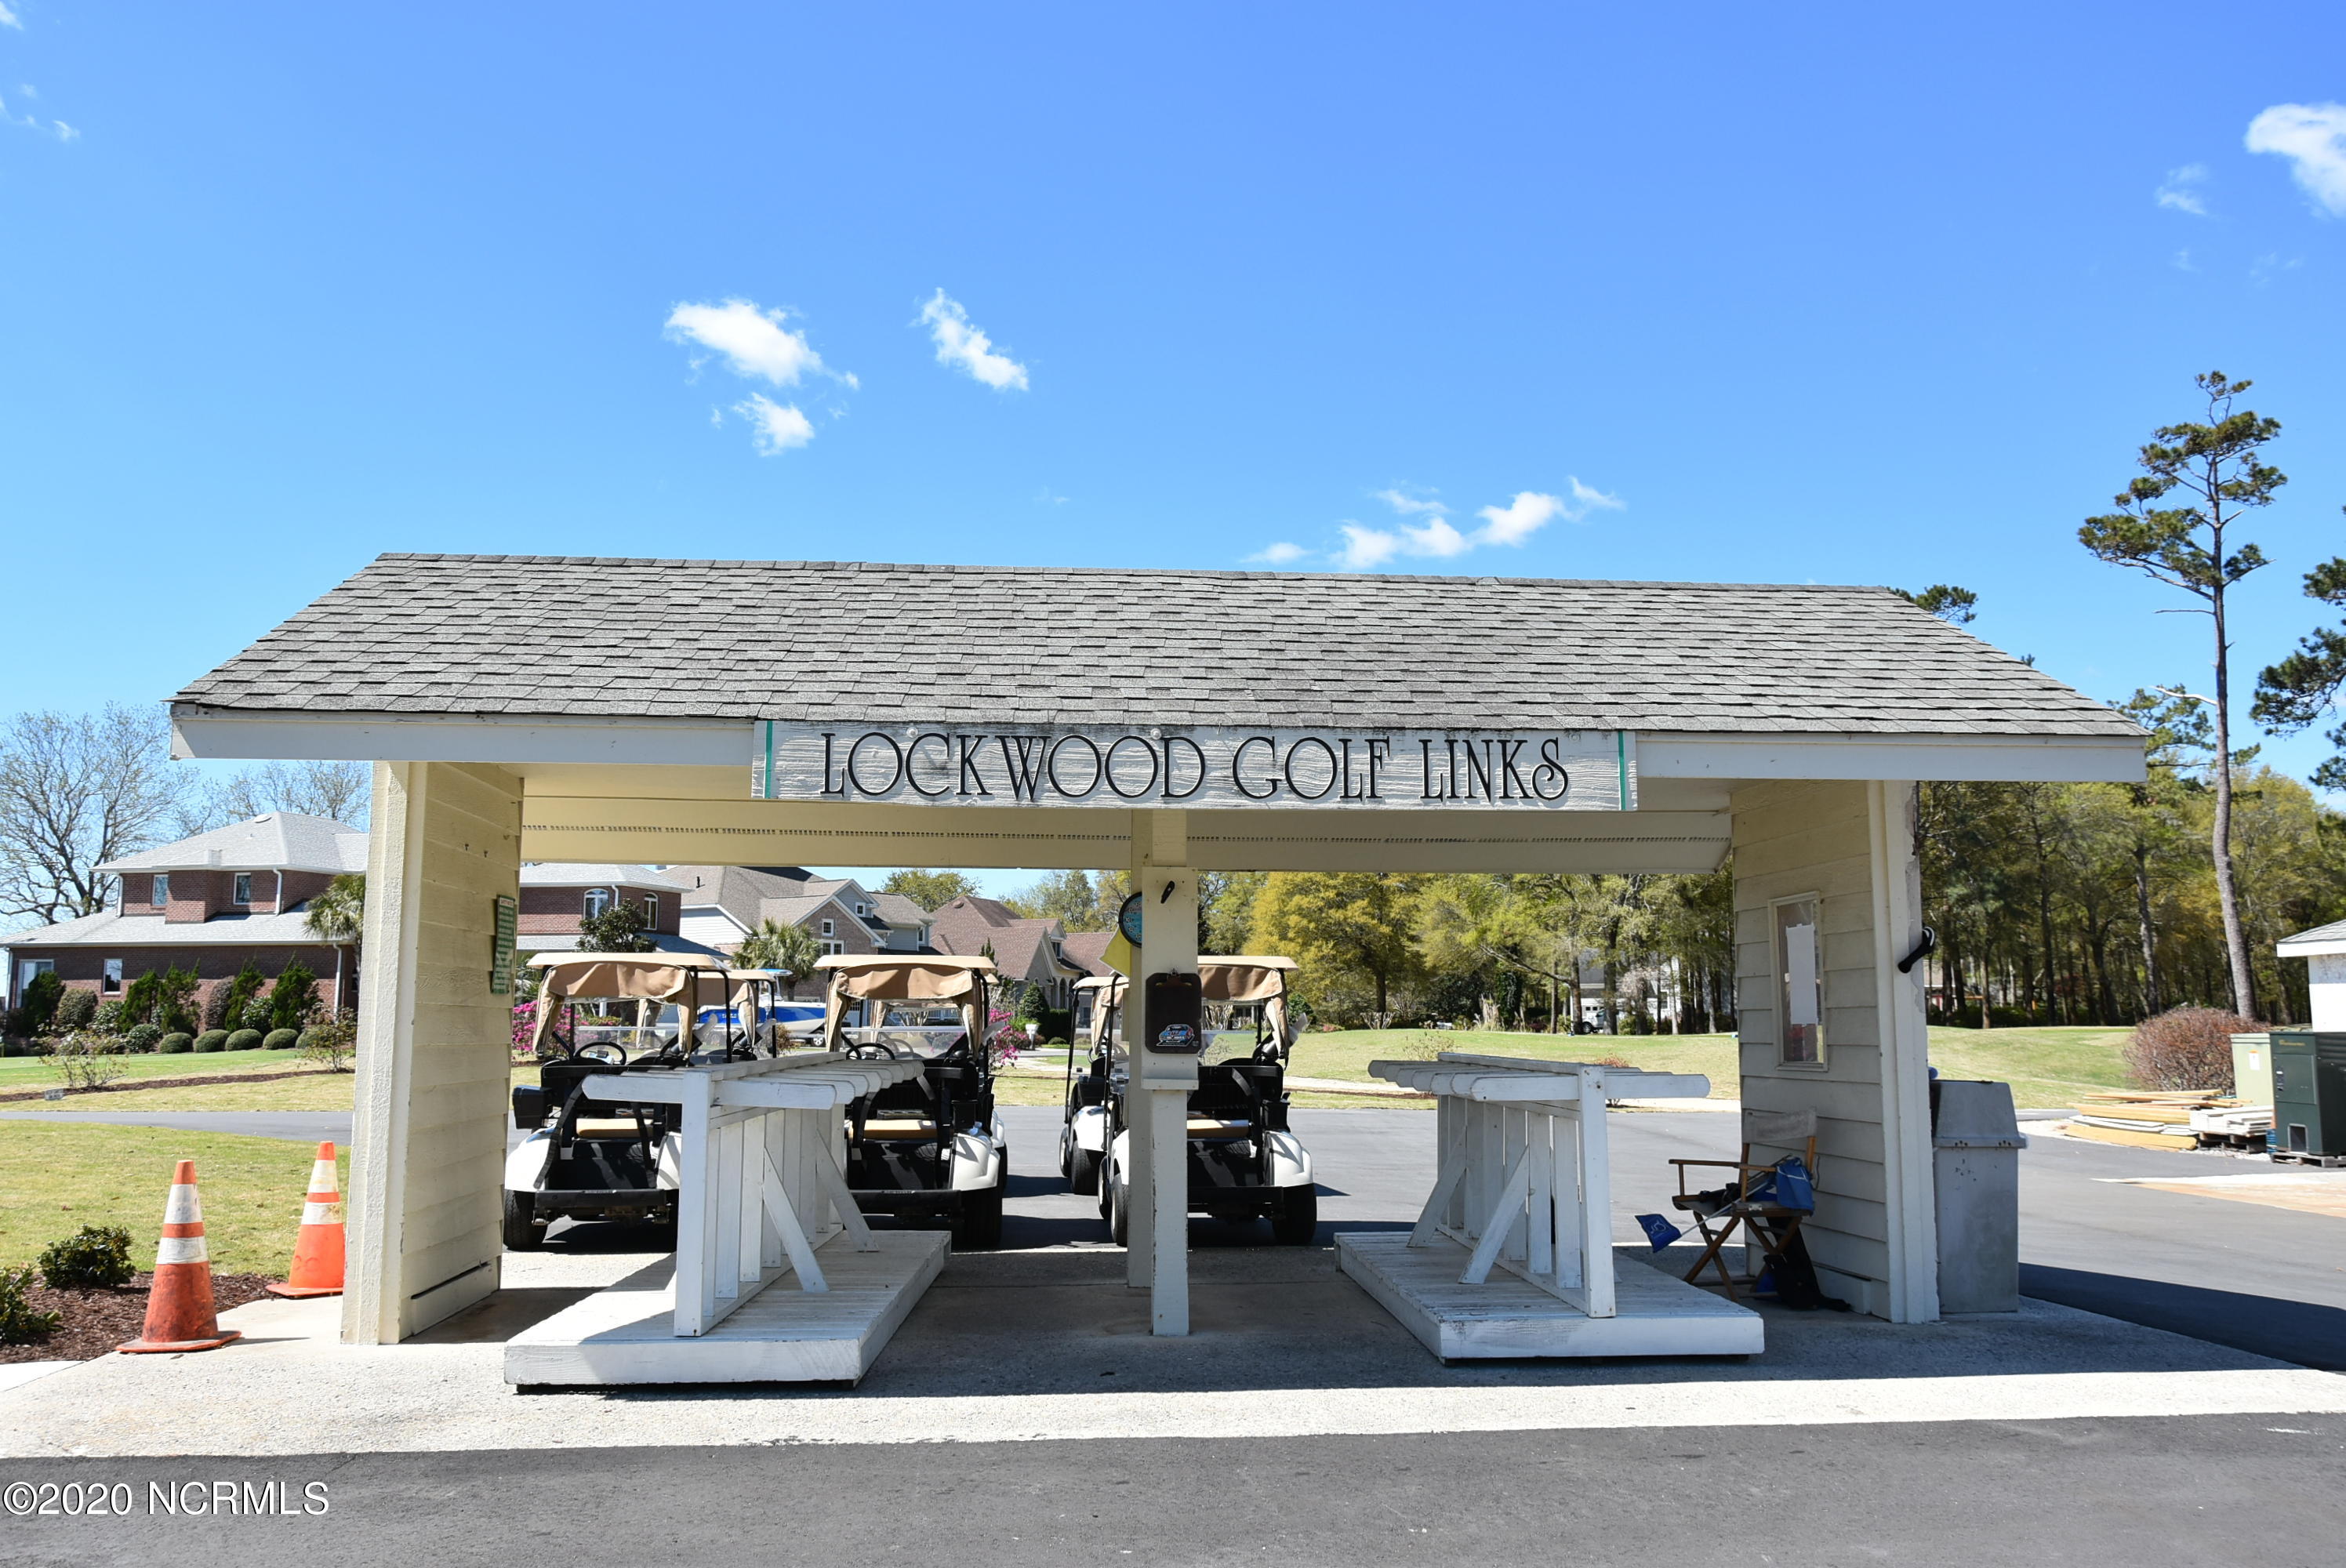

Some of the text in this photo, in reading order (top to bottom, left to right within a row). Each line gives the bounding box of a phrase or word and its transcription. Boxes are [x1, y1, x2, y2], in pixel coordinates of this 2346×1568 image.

[820, 731, 1569, 803] LOCKWOOD GOLF LINKS
